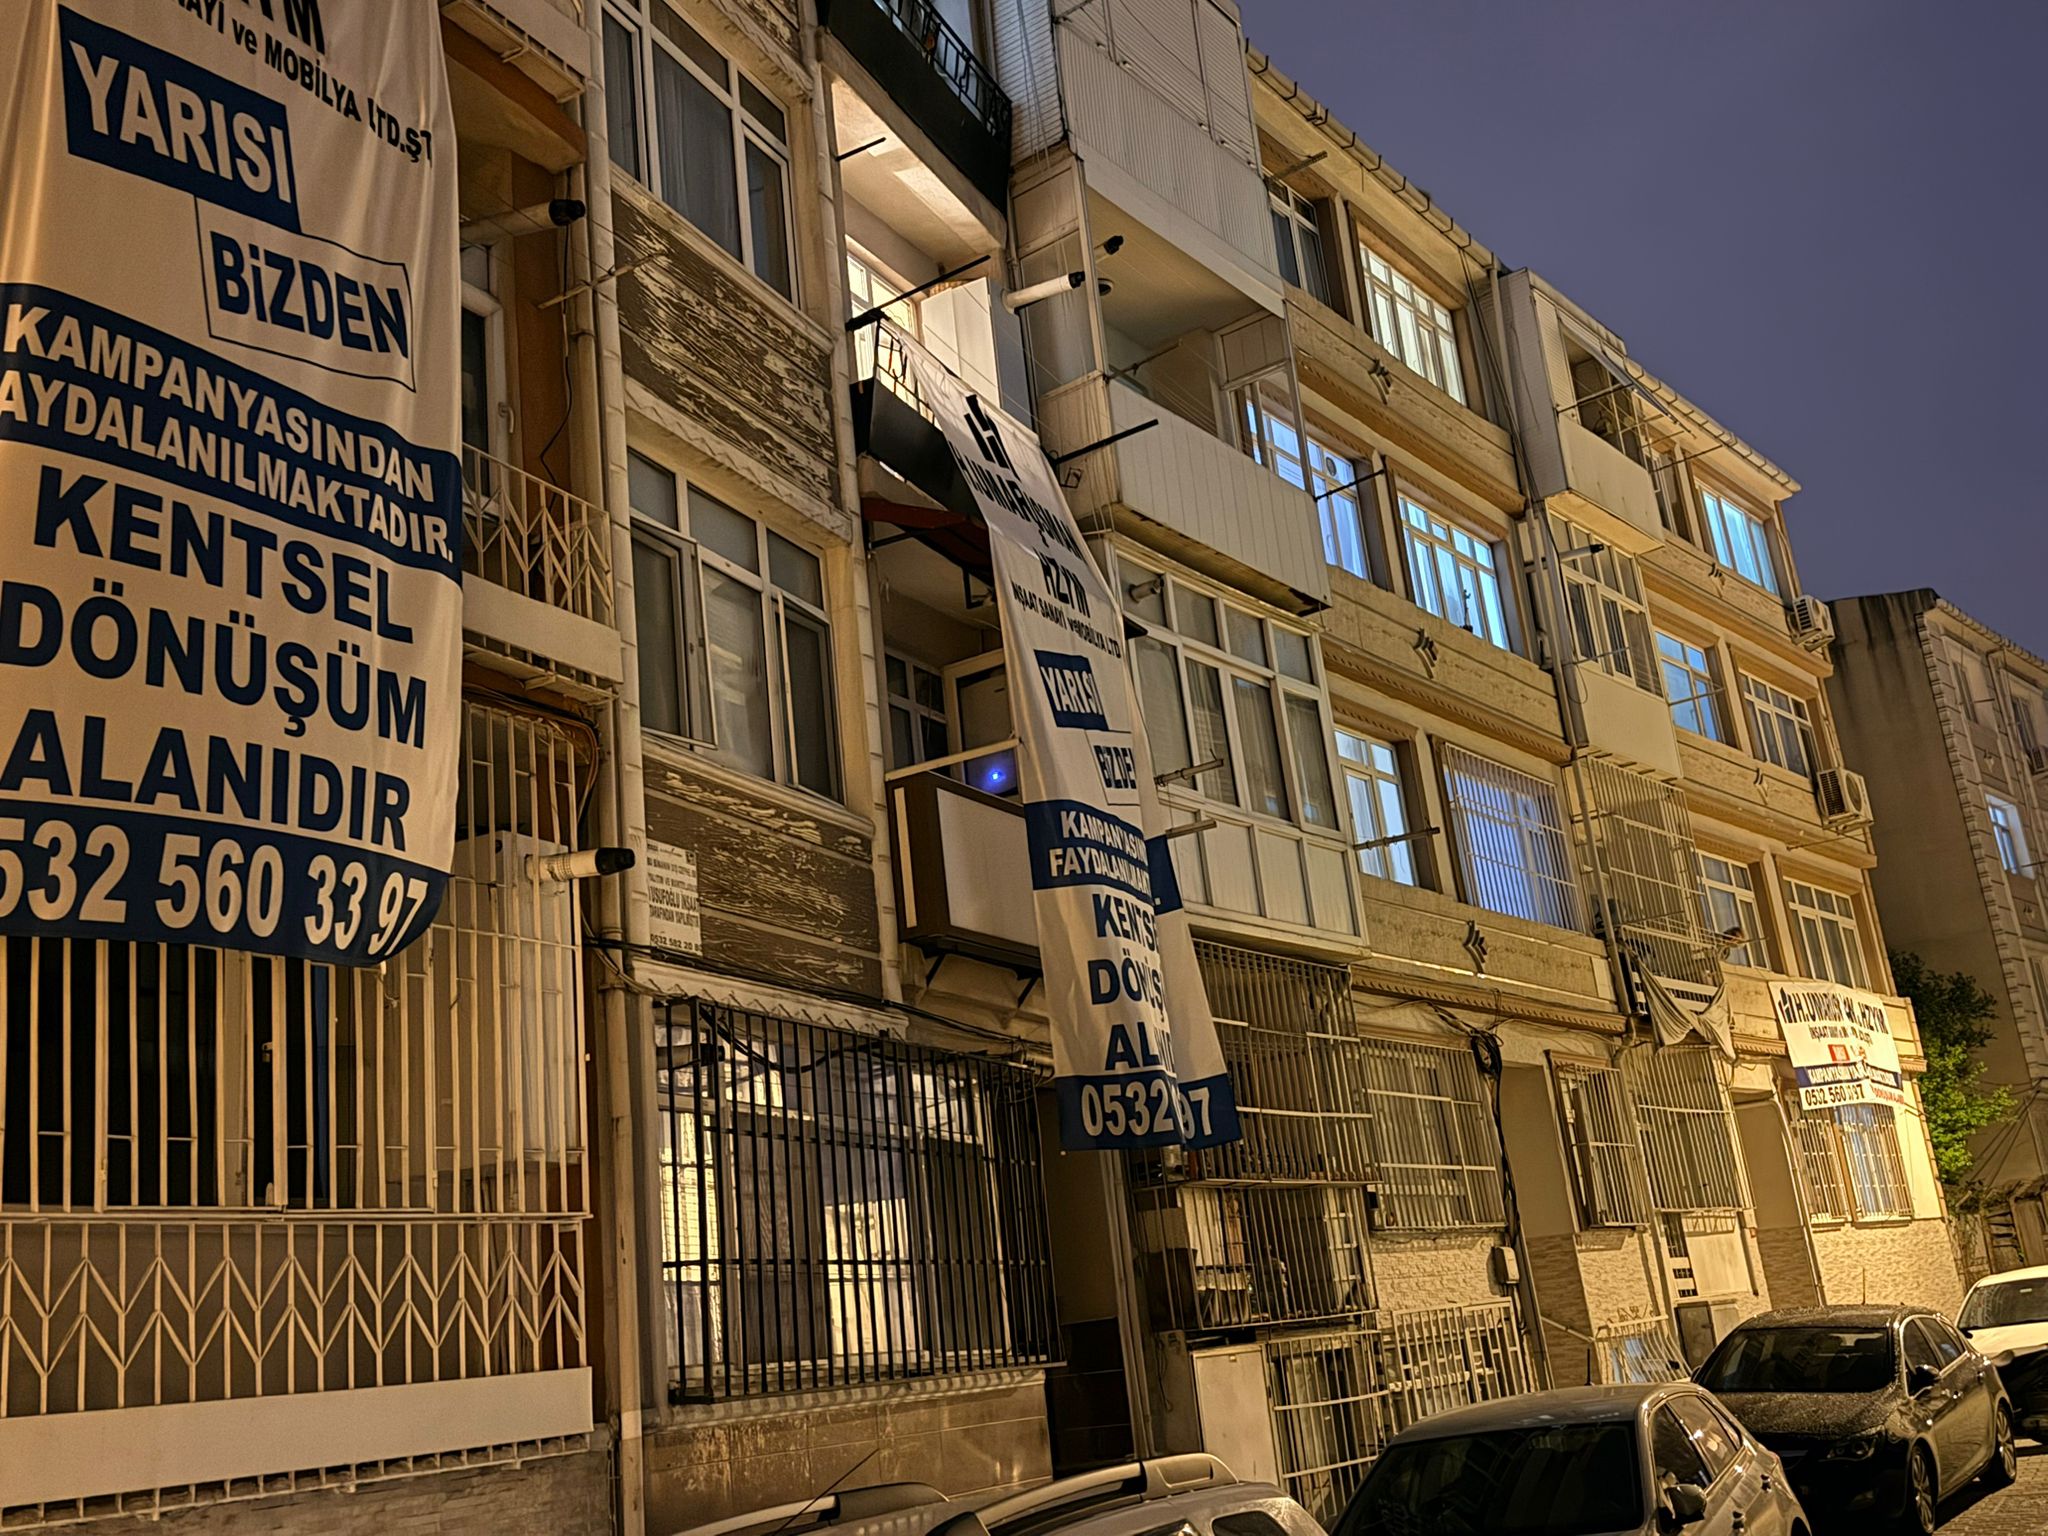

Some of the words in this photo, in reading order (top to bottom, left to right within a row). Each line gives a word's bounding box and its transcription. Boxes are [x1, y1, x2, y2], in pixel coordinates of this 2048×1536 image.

[69, 40, 292, 204] YARISI
[232, 18, 258, 55] ve
[265, 33, 362, 122] MOBİLYA
[3, 303, 434, 503] KAMPANYASINDAN
[34, 464, 414, 645] KENTSEL
[0, 577, 427, 750] DÖNÜŞÜM
[1040, 666, 1103, 715] YARISI
[0, 708, 411, 853] ALANIDIR
[155, 833, 285, 939] 560
[304, 854, 368, 952] 33
[367, 871, 429, 957] 97
[1081, 1078, 1174, 1137] 0532
